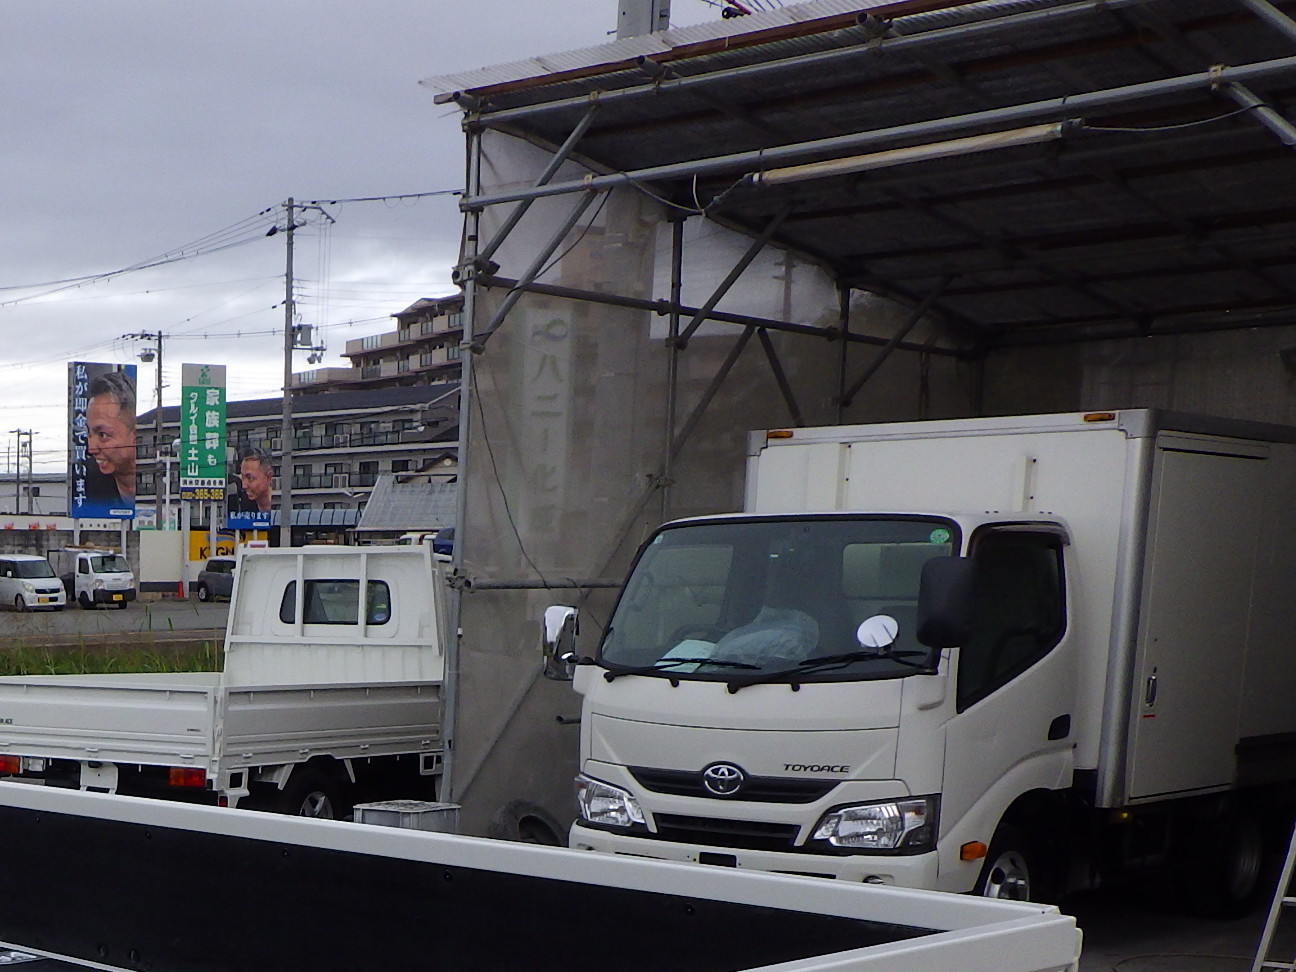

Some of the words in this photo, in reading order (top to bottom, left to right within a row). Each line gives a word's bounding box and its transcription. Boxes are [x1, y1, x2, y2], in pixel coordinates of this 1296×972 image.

[73, 364, 89, 509] 私が即金で買います
[783, 763, 851, 774] TOYOACE
